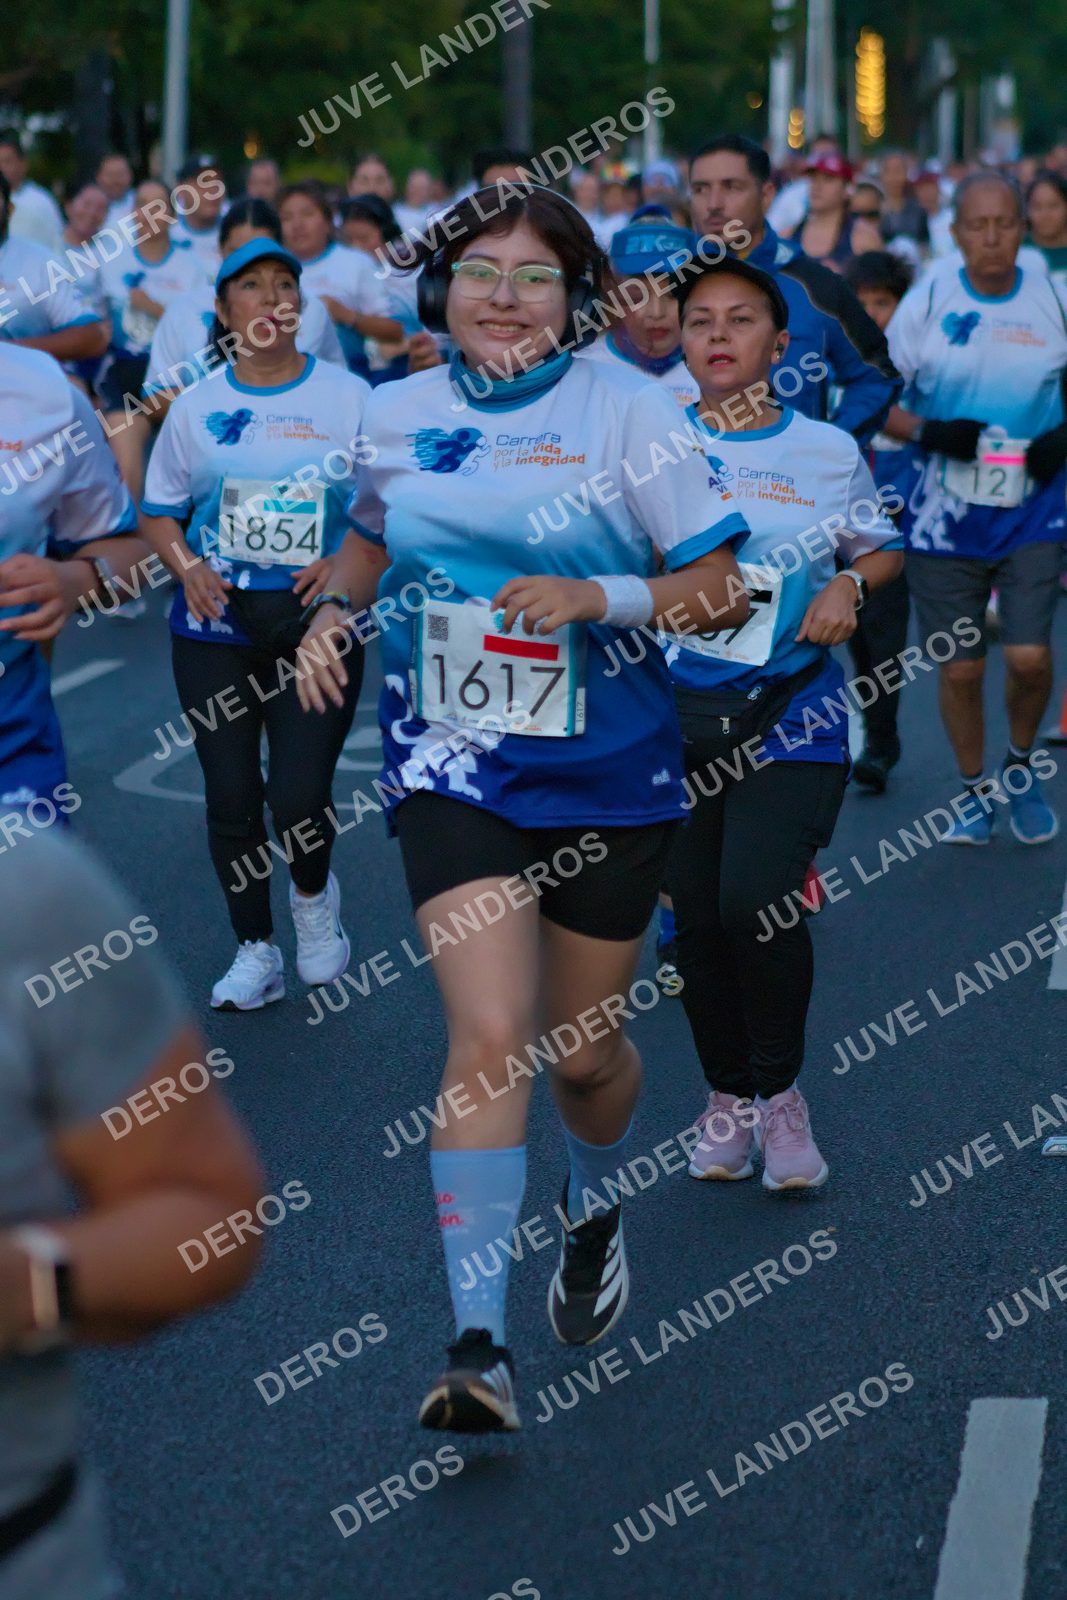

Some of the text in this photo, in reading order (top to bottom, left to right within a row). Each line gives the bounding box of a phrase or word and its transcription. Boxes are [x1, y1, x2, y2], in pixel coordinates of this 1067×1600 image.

[494, 447, 515, 460] por
[518, 446, 529, 457] la
[515, 453, 586, 466] Integridad
[738, 466, 794, 486] Carrera
[737, 479, 797, 495] por la Vida
[745, 488, 755, 498] la
[758, 490, 816, 507] Integridad
[226, 514, 320, 555] 1854
[432, 653, 566, 719] 1617
